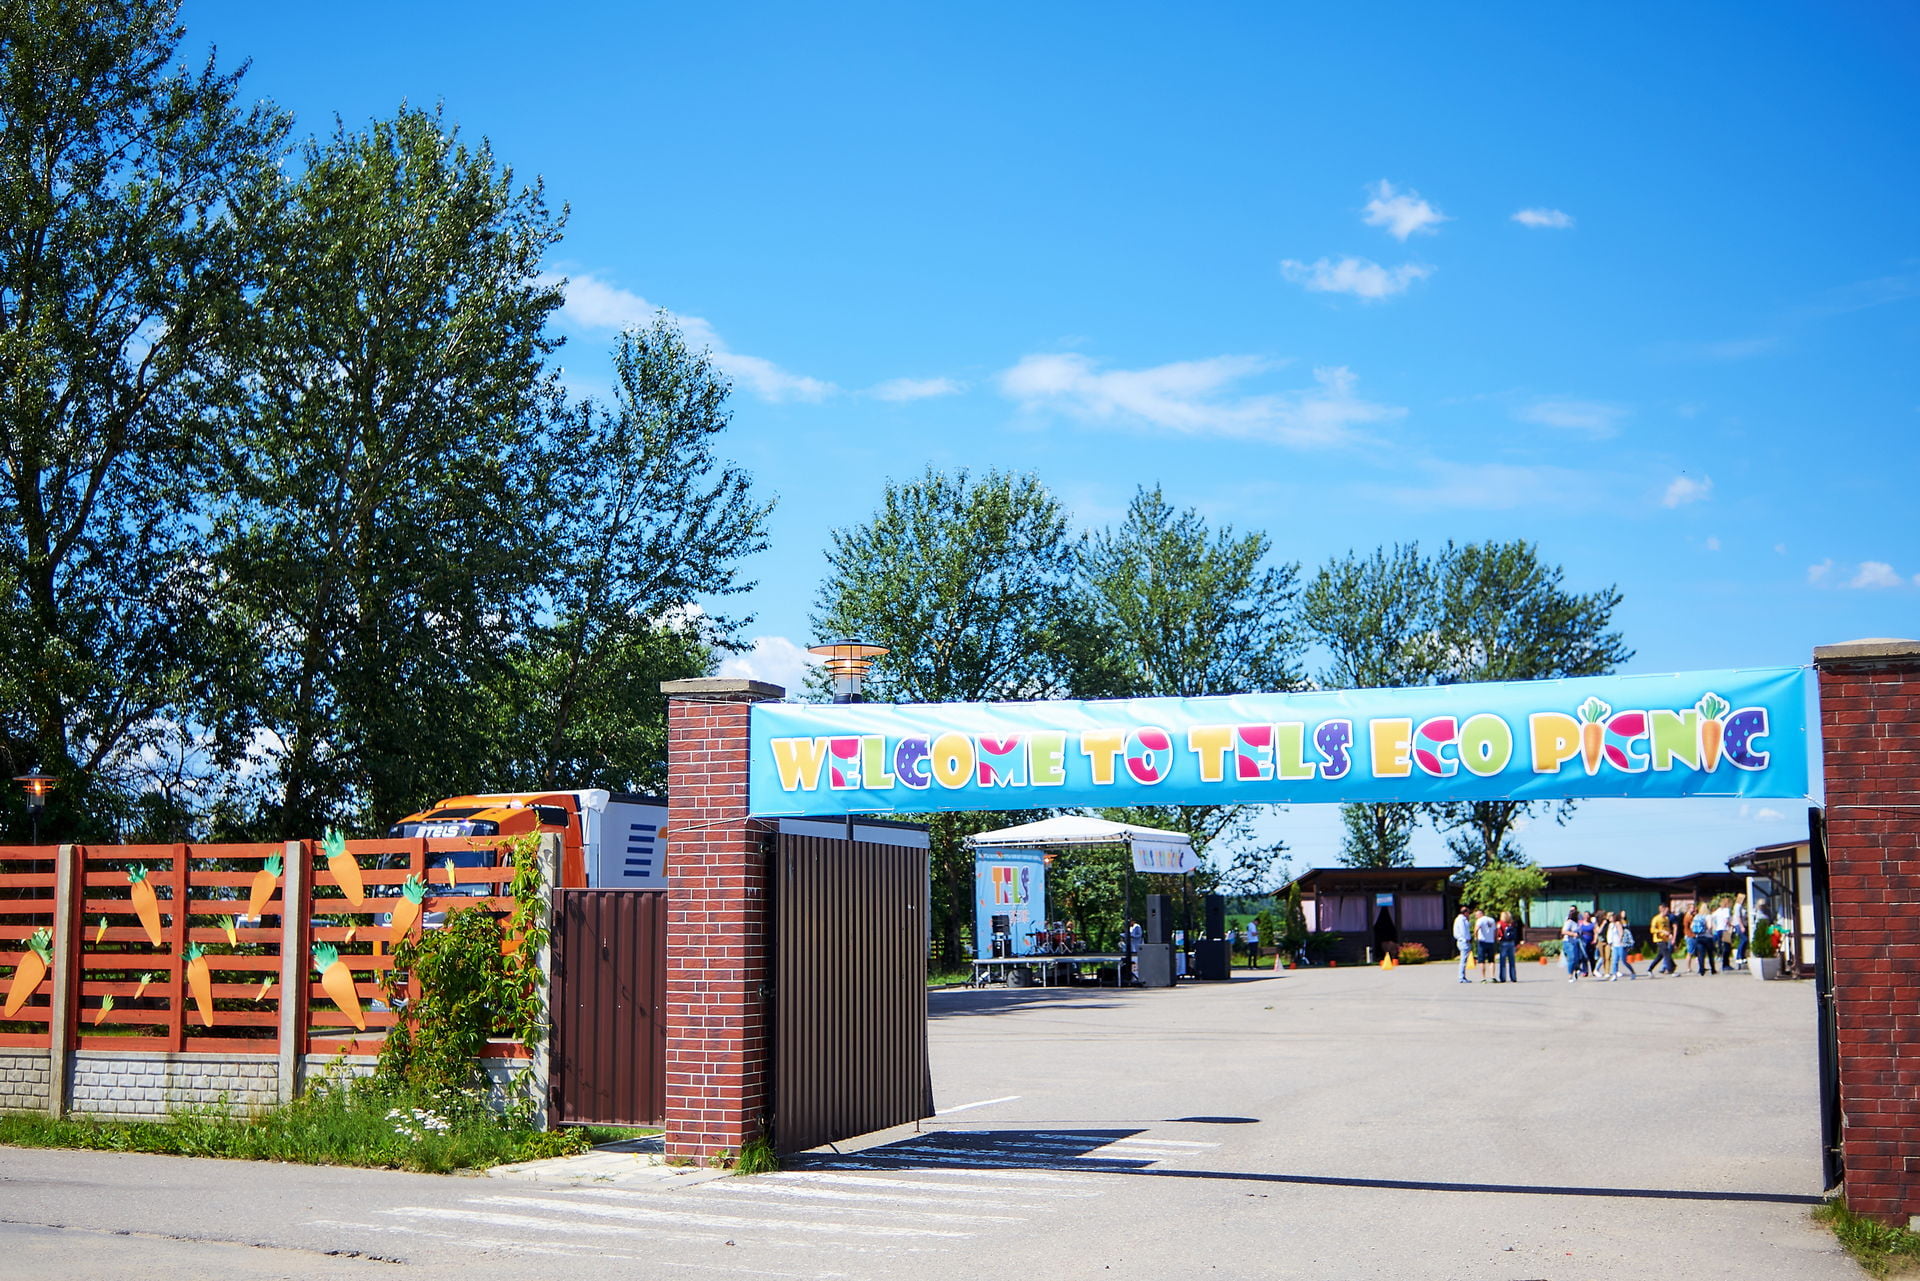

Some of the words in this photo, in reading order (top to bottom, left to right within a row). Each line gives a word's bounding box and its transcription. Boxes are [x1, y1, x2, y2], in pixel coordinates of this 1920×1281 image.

[771, 730, 1067, 791] WELCOME
[1081, 725, 1173, 786] TO
[1188, 719, 1353, 782] TELS
[1369, 713, 1513, 779] ECO
[1529, 691, 1770, 775] PICNIC
[991, 865, 1030, 905] TELS
